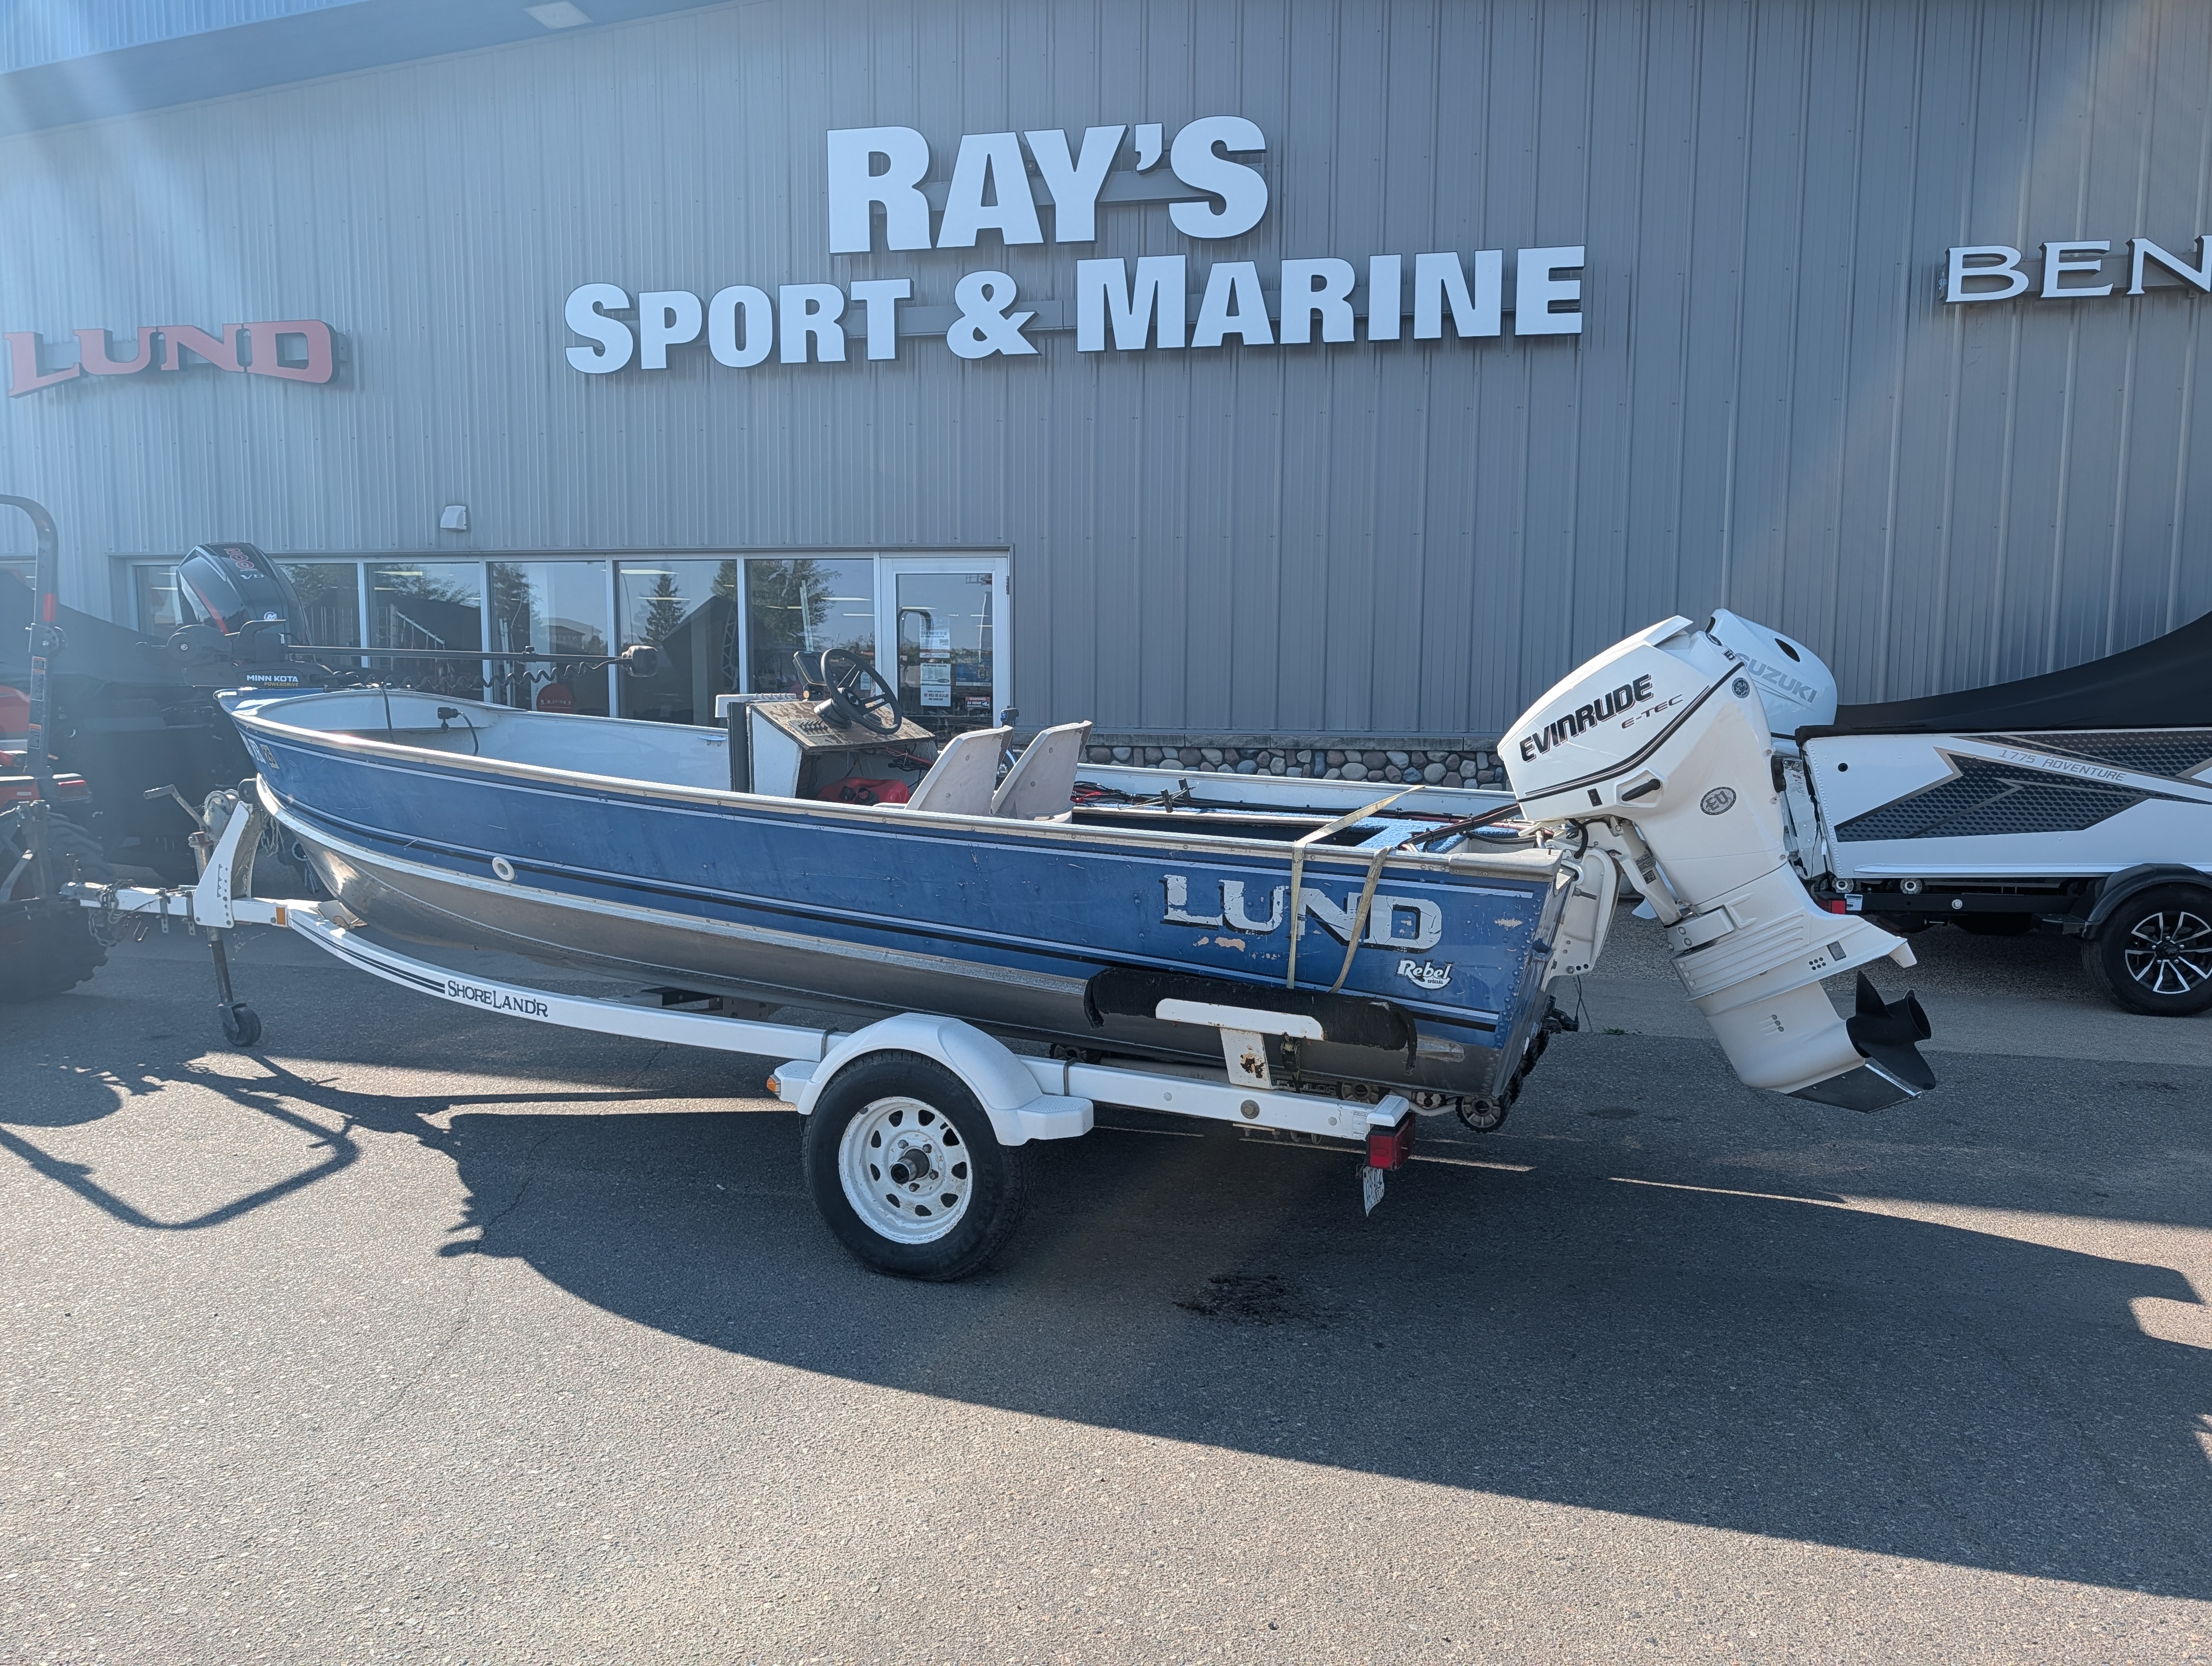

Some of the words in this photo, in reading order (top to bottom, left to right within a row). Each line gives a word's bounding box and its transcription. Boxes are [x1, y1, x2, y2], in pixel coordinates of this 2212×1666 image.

[826, 115, 1269, 255] RAY'S
[564, 278, 914, 374] SPORT
[946, 270, 1040, 360] &
[1076, 244, 1585, 354] MARINE
[3, 319, 337, 398] LUND
[1621, 694, 1683, 729] E-TEC
[1736, 652, 1818, 703] SUZUKI
[1519, 673, 1654, 763] EVINRUDE
[1998, 749, 2037, 764] 1775
[2041, 758, 2127, 781] ADVENTURE
[1162, 874, 1443, 952] LUND
[1397, 959, 1453, 980] Rebel
